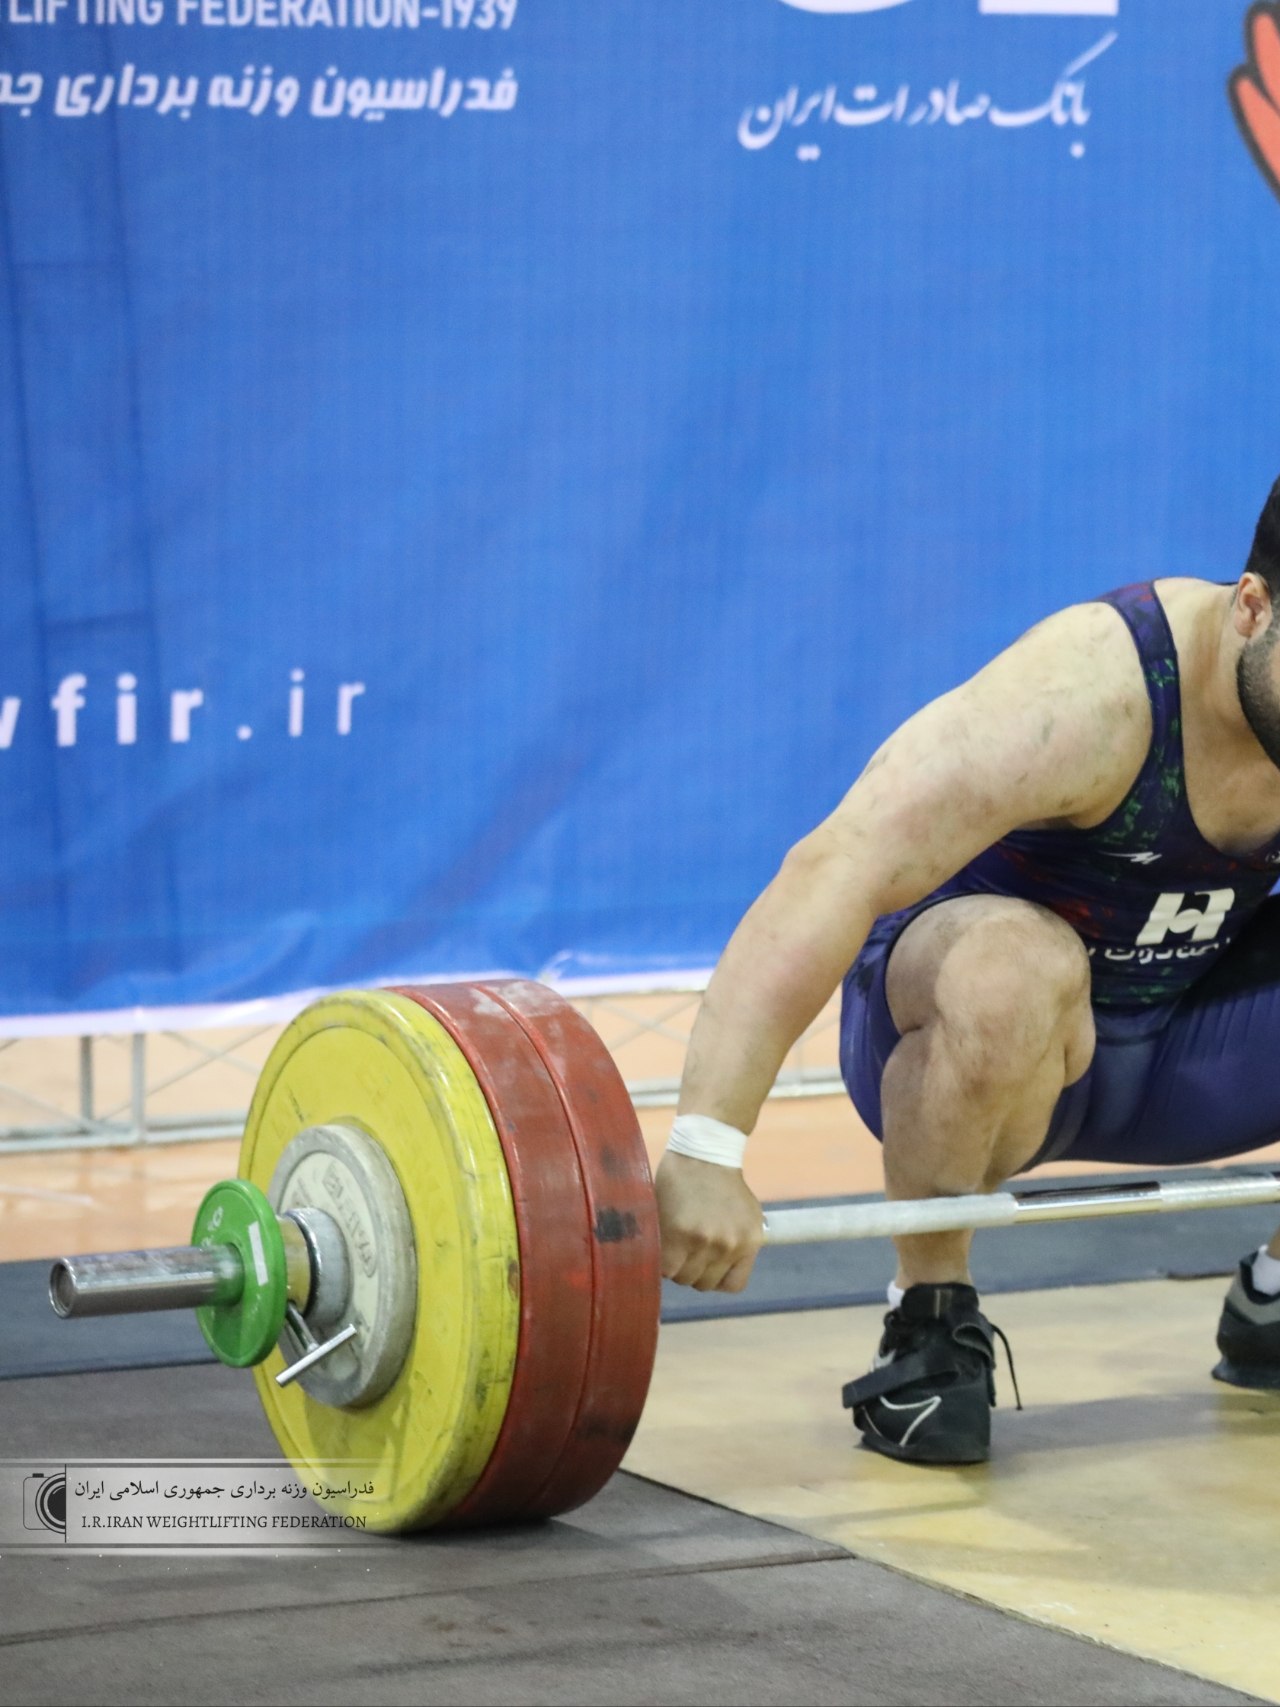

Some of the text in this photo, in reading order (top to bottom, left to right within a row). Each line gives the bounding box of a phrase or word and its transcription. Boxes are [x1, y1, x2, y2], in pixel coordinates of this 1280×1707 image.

[53, 62, 199, 120] برداری
[207, 65, 300, 118] وزنه
[309, 66, 519, 121] فدراسیون
[737, 31, 1118, 162] بانک صادرات ایران
